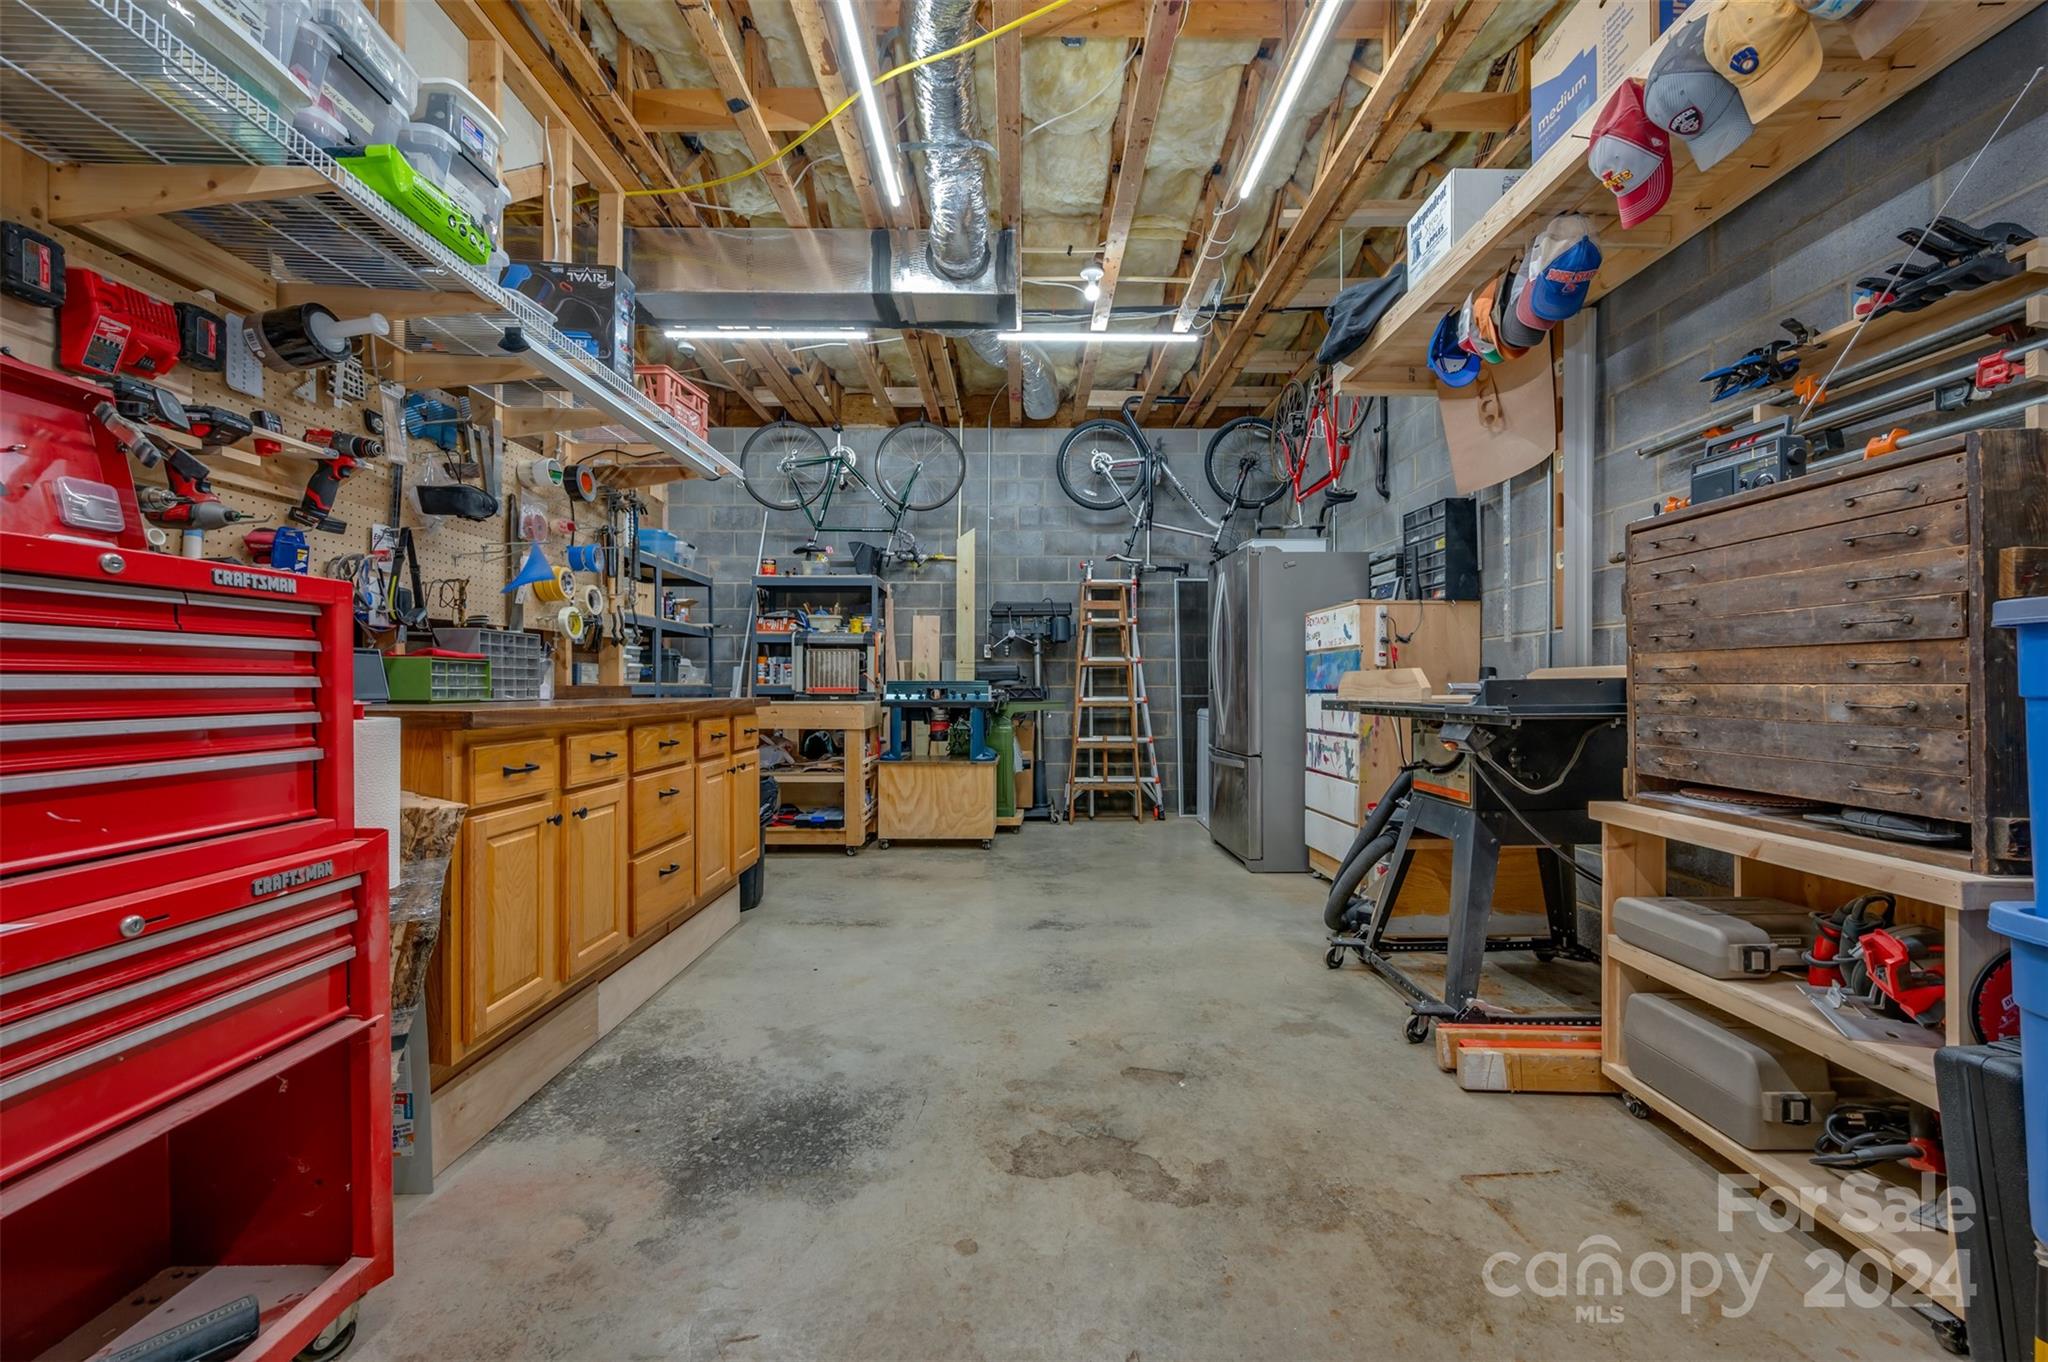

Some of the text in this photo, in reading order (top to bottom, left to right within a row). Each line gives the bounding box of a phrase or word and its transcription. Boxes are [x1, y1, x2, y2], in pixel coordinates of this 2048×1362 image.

[1538, 74, 1587, 132] medium
[1410, 185, 1447, 239] Independent
[1426, 224, 1444, 248] APPLES
[567, 270, 608, 282] RIVAL
[212, 567, 297, 595] CRAFTSMAN
[252, 859, 334, 897] CRAFTSMAN
